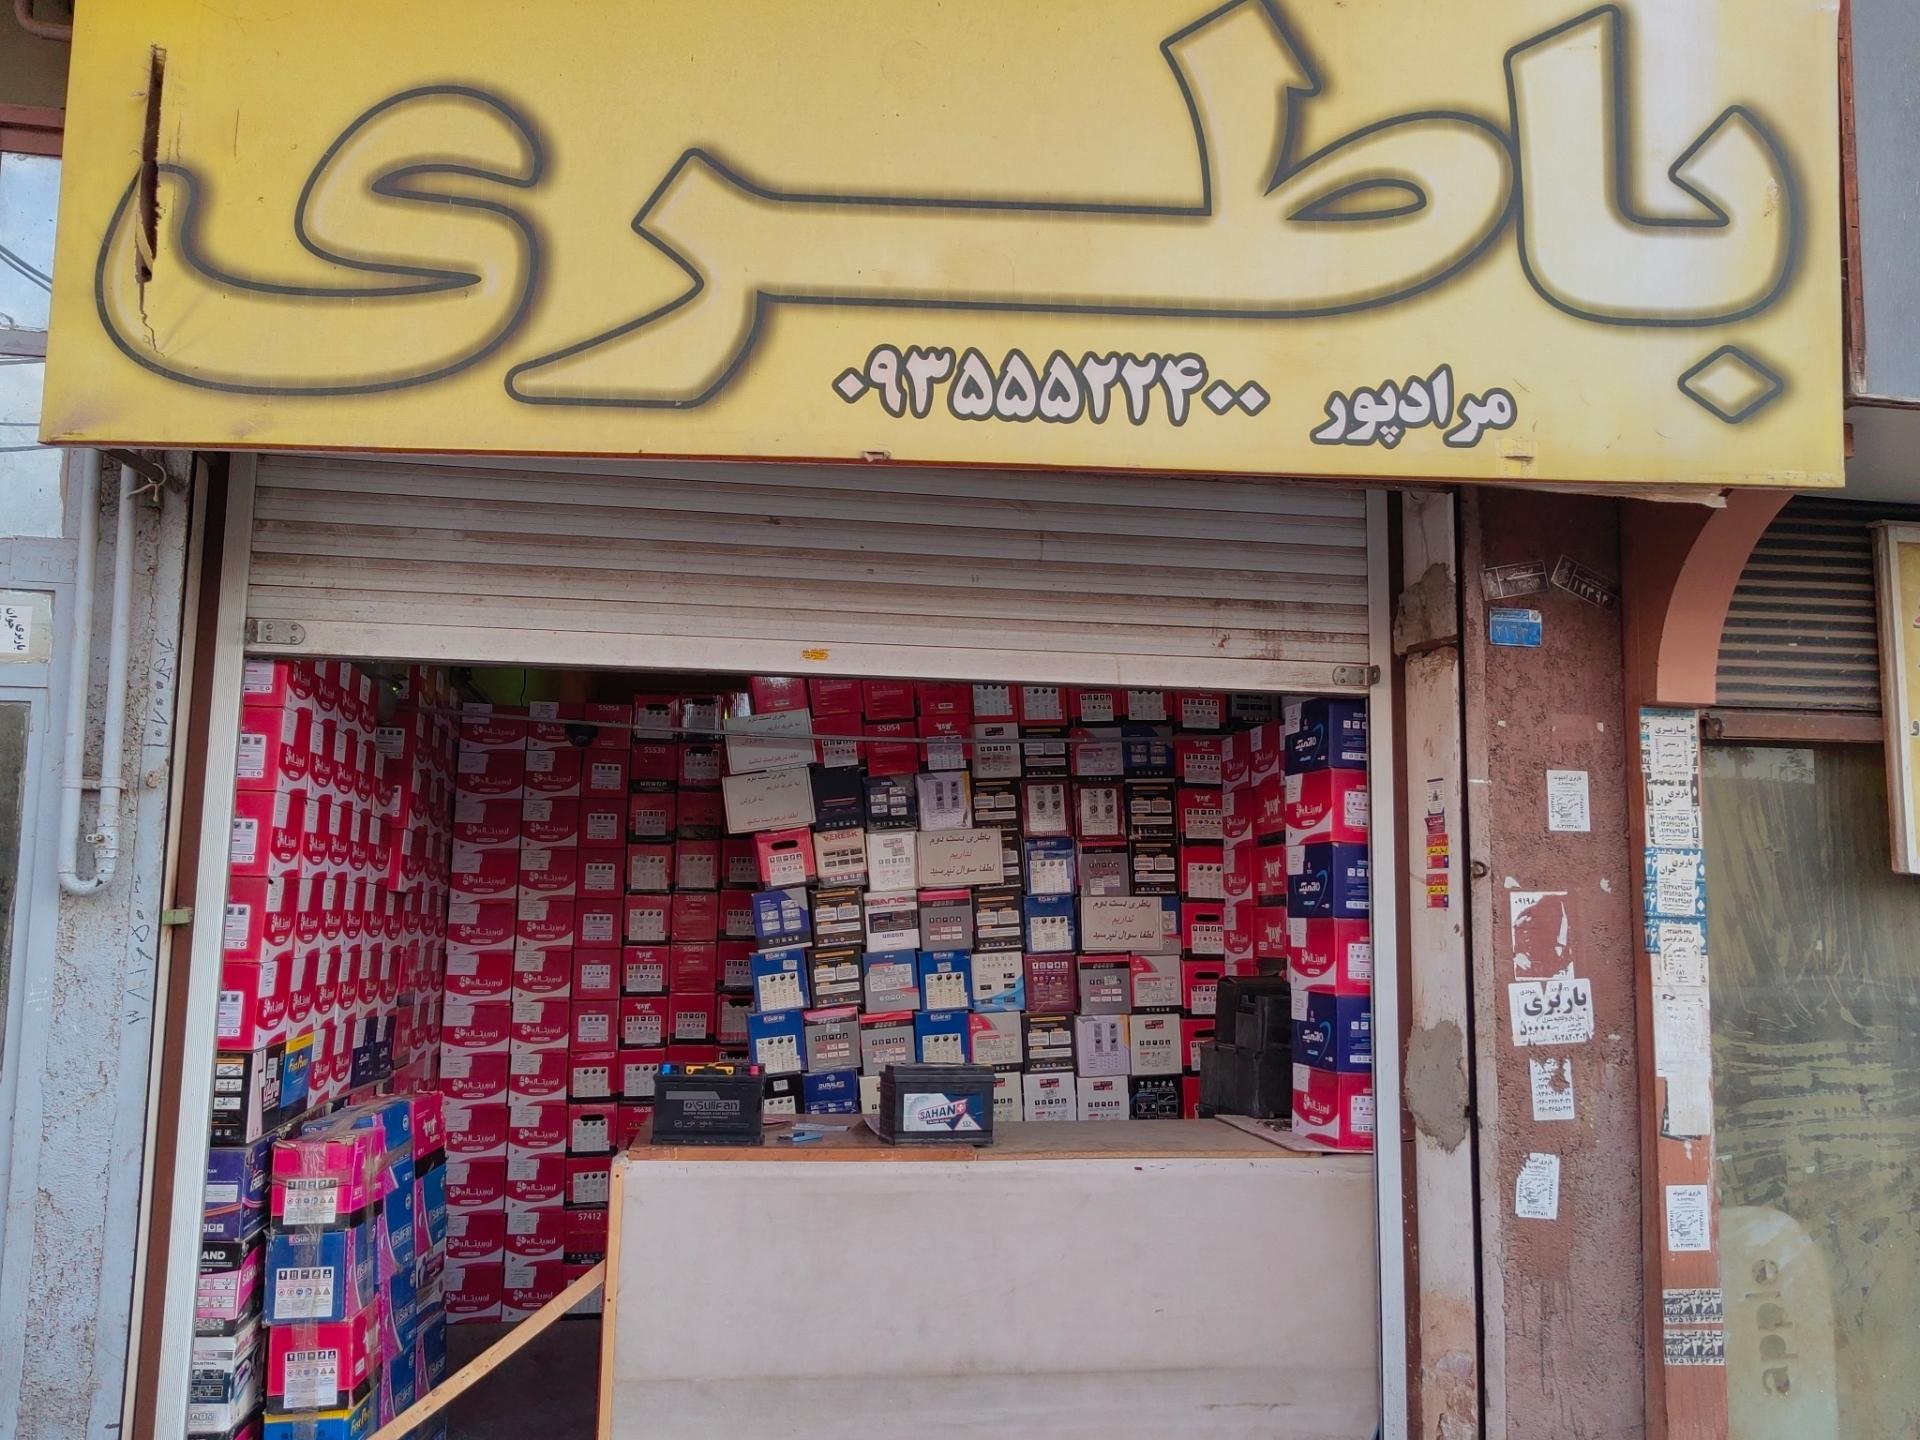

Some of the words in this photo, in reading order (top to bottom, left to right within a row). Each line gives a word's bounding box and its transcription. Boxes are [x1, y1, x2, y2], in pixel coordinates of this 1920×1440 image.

[96, 0, 1797, 424] باطری
[832, 343, 1271, 427] ۰۹۳۵۵۵۲۲۴۰۰
[1311, 363, 1517, 449] مرادپور
[1524, 985, 1587, 1016] باربری
[919, 1103, 956, 1120] SAHAN
[578, 1212, 602, 1221] 57412
